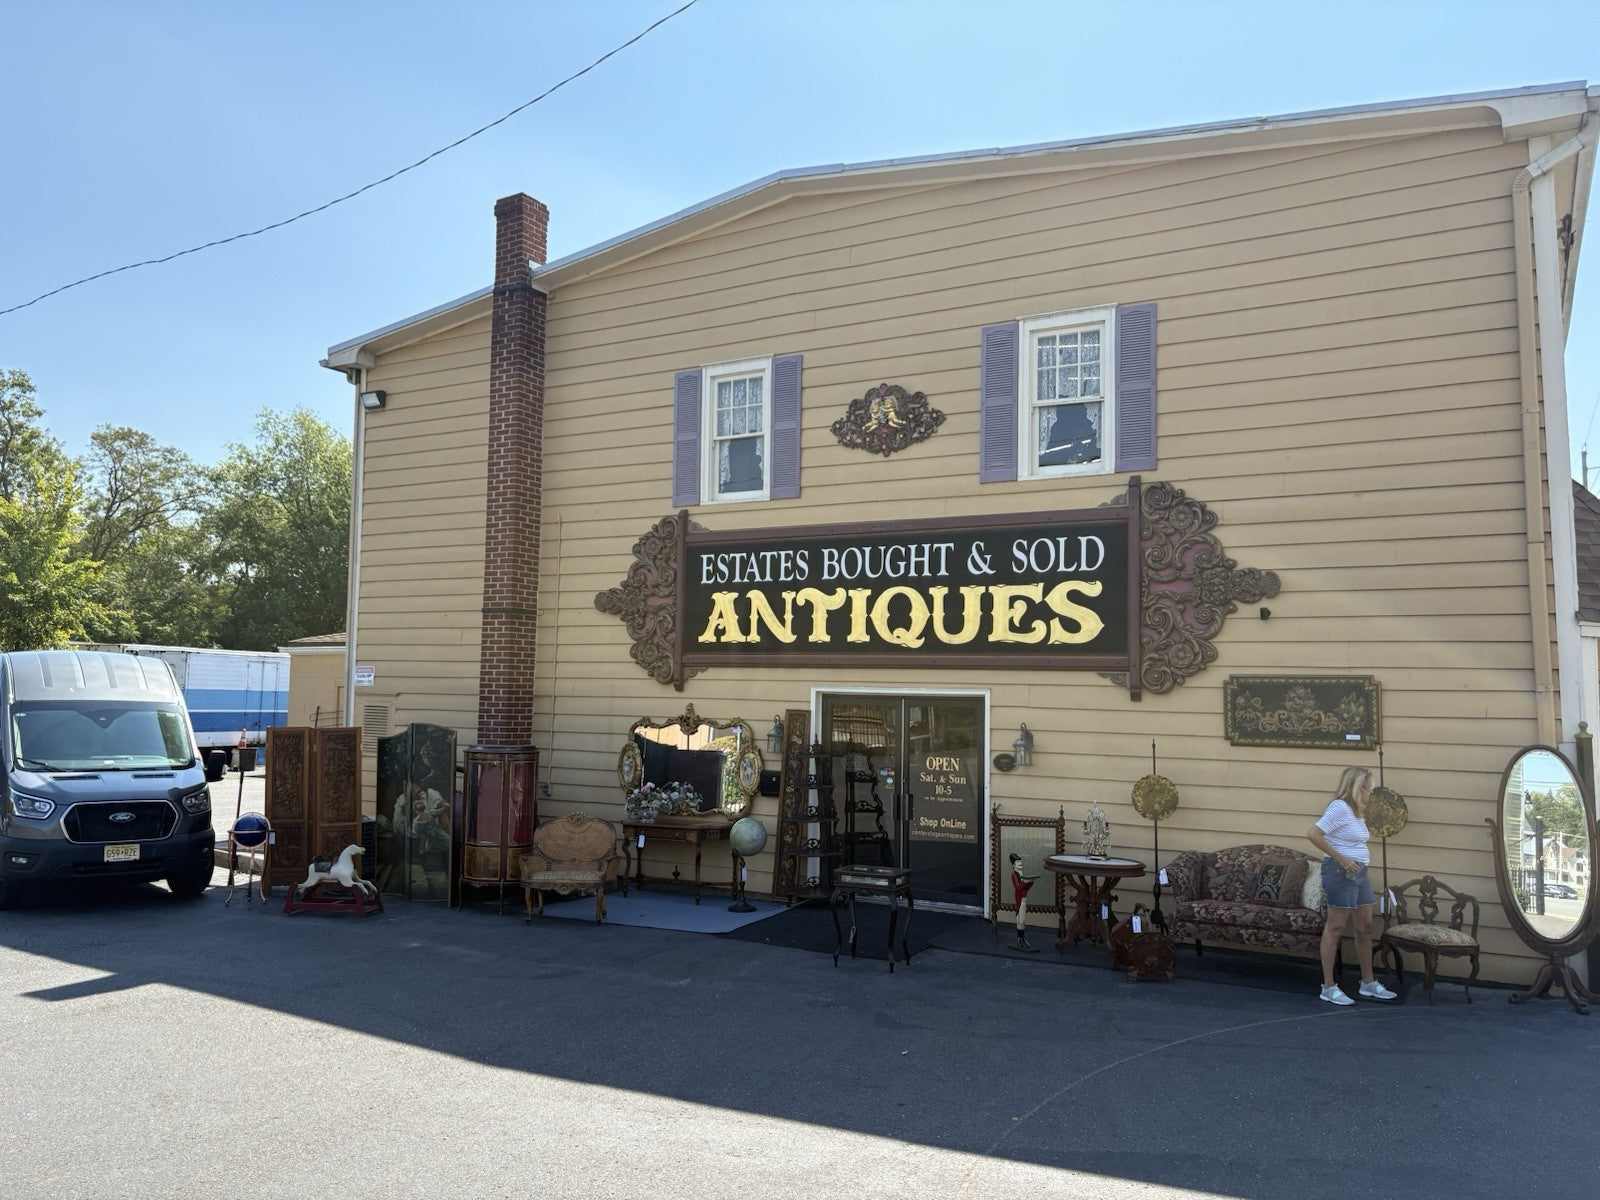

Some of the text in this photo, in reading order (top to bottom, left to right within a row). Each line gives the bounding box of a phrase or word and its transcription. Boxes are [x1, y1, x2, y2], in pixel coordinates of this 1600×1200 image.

[700, 535, 1106, 584] ESTATES BOUGHT & SOLD
[698, 580, 1106, 649] ANTIQUES
[926, 756, 960, 771] OPEN
[920, 771, 967, 785] Sat. & Sun
[935, 784, 953, 795] 10-5
[920, 816, 939, 829] Shop
